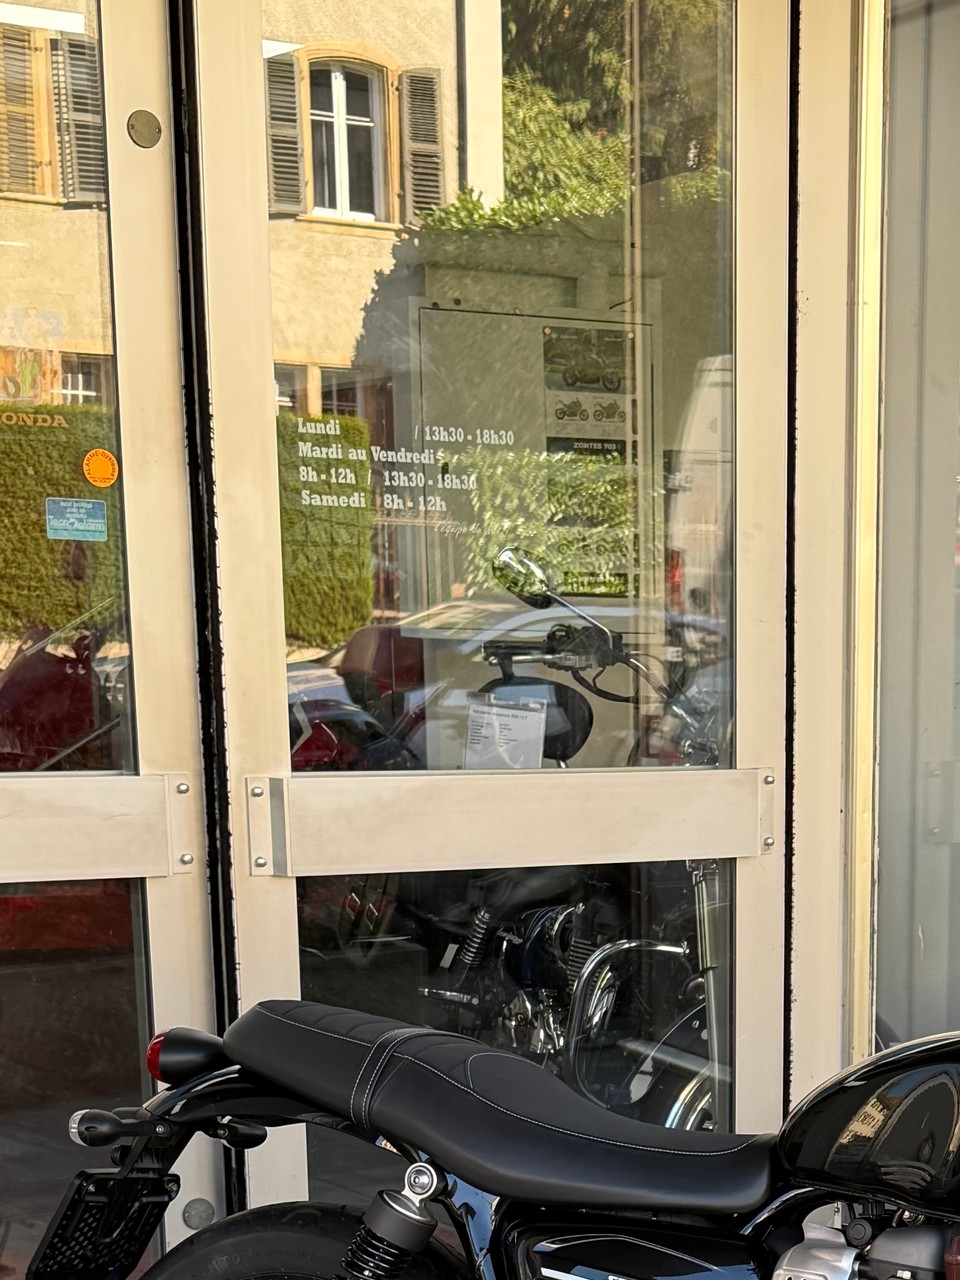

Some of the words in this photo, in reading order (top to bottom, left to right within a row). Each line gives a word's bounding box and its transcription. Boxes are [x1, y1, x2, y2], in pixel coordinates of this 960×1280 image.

[0, 411, 69, 428] ONDA
[298, 418, 340, 435] Lundi
[425, 426, 464, 442] 13h30
[475, 428, 515, 445] 18h30
[298, 442, 342, 459] Mardi
[348, 449, 367, 461] au
[371, 446, 435, 464] Vendredi
[299, 466, 318, 482] 8h
[330, 468, 356, 484] 12h
[384, 471, 425, 487] 13h30
[437, 473, 477, 490] 18h30
[301, 490, 366, 508] Samedi
[384, 494, 405, 509] 8h
[418, 495, 447, 511] 12h
